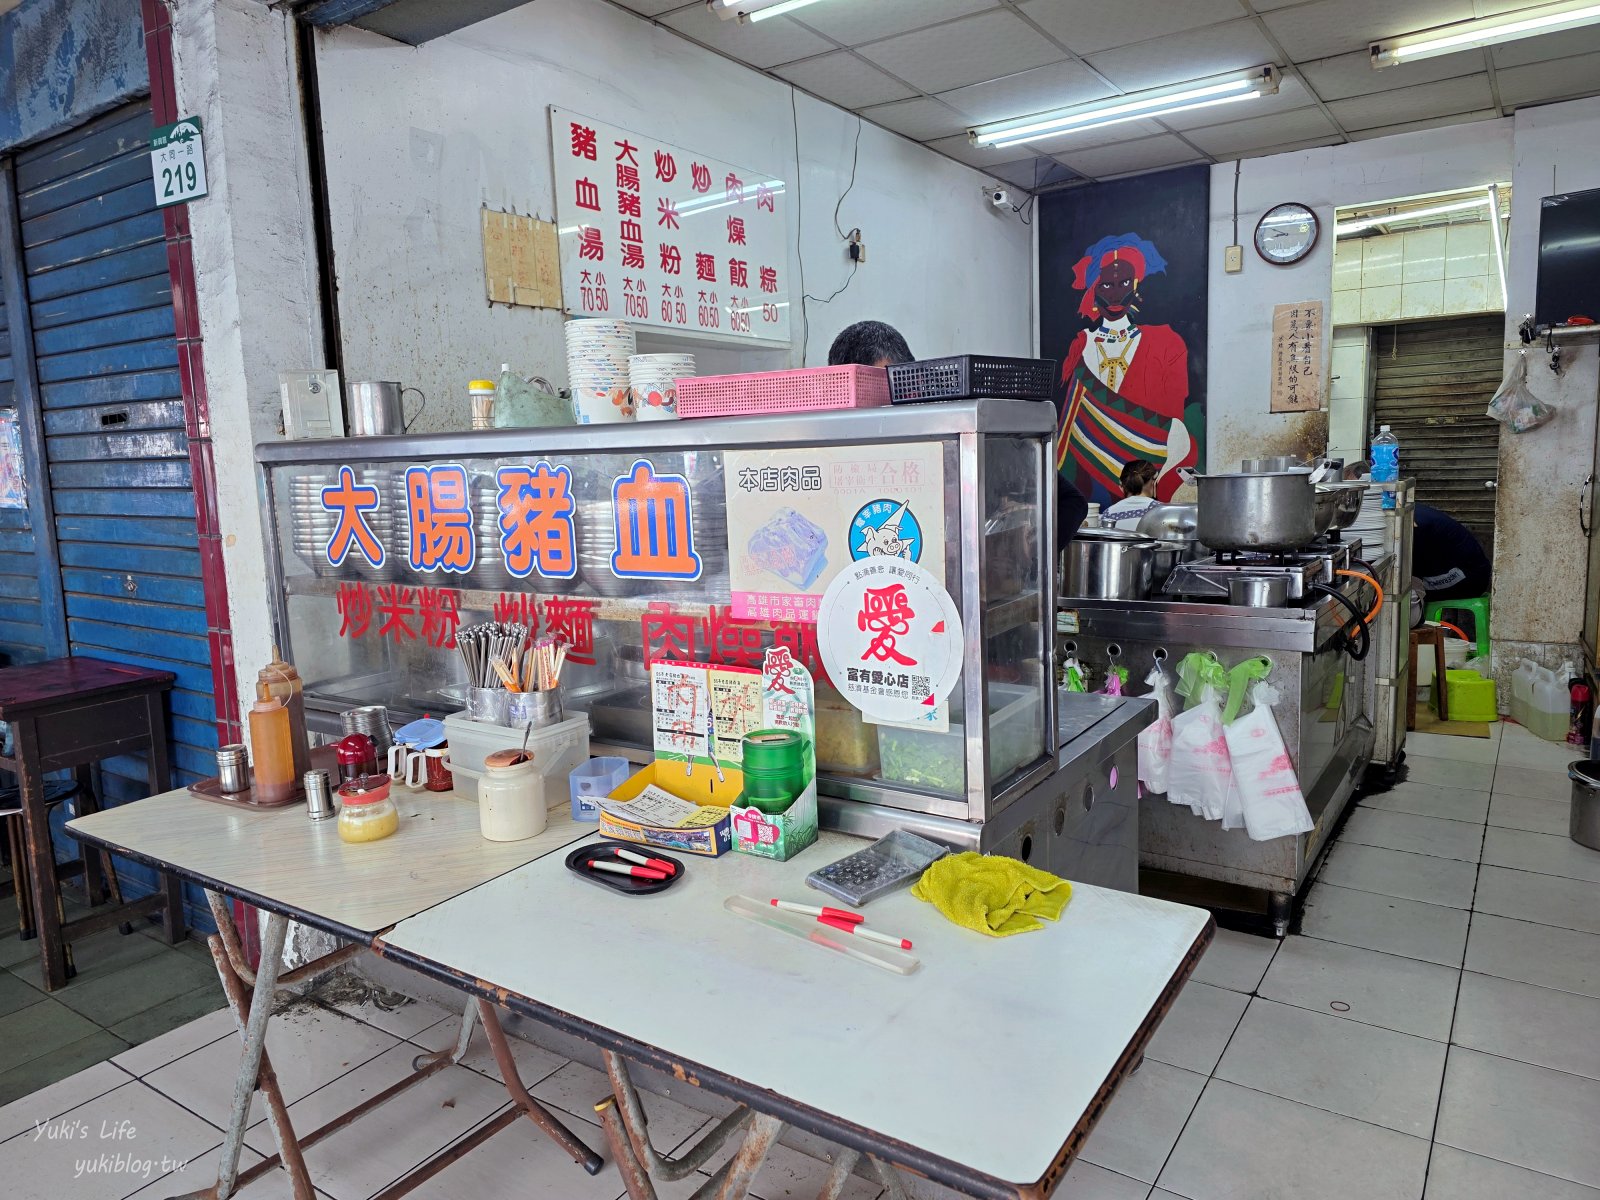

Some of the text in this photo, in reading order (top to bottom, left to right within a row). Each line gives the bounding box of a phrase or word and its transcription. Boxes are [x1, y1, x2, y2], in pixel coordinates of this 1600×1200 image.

[161, 144, 193, 163] 大同一路
[162, 161, 197, 197] 219
[570, 121, 604, 262] 豬血湯
[614, 139, 645, 270] 大腸豬血湯
[654, 150, 682, 275] 炒米粉
[691, 161, 717, 283] 炒麵
[725, 173, 749, 289] 肉燥飯
[756, 183, 778, 293] 肉粽
[580, 286, 609, 312] 70 50
[623, 293, 648, 319] 70 50
[661, 300, 687, 324] 60 50
[698, 305, 720, 329] 60 50
[730, 308, 750, 332] 60 50
[762, 302, 778, 323] 50
[1302, 309, 1315, 376] 不要小看自己
[738, 466, 822, 492] 本店肉品
[881, 460, 920, 484] 合格
[320, 458, 703, 581] 大腸豬血
[747, 594, 822, 608] 高雄市家畜肉
[336, 581, 460, 651] 炒米粉
[494, 592, 597, 666] 炒麵
[847, 668, 909, 689] 富有愛心店
